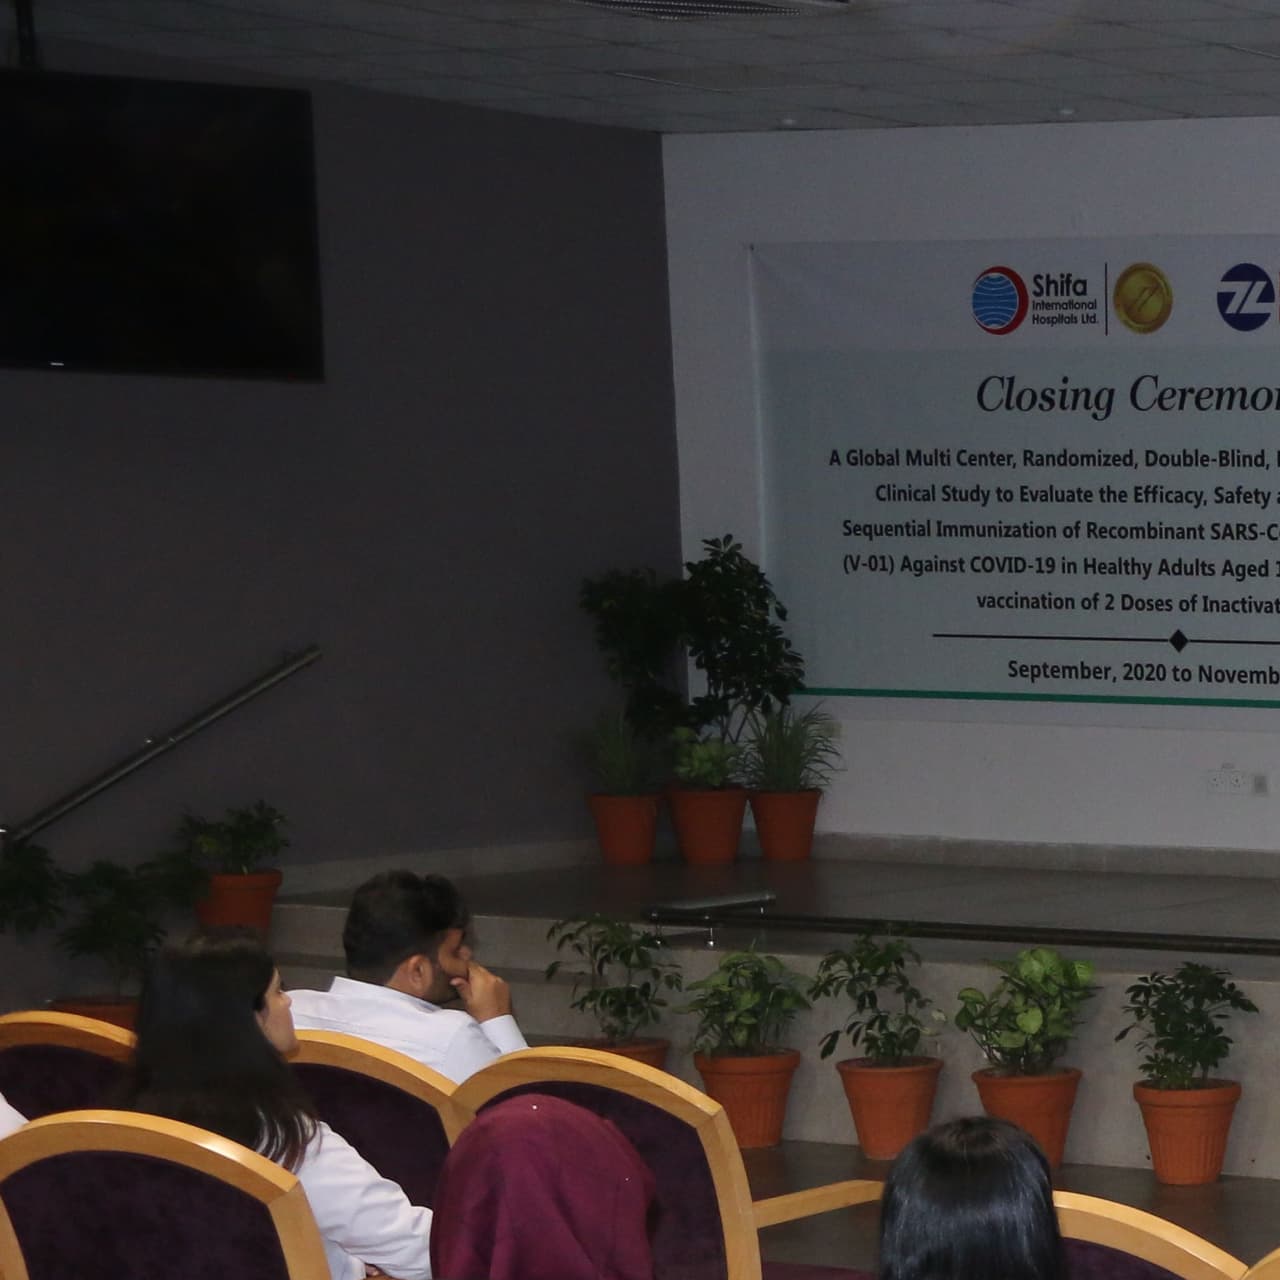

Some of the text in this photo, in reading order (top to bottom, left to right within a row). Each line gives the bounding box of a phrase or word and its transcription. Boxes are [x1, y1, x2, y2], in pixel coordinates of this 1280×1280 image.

[1032, 272, 1088, 298] Shifa
[1031, 299, 1098, 311] International
[1031, 313, 1099, 328] Hospitals Ltd.
[976, 375, 1116, 422] Closing
[829, 449, 842, 466] A
[846, 448, 900, 467] Global
[905, 448, 951, 467] Multi
[956, 448, 1017, 469] Center,
[1023, 448, 1139, 470] Randomized,
[1144, 448, 1270, 471] Double-Blind,
[875, 483, 936, 502] Clinical
[941, 483, 991, 508] Study
[995, 486, 1014, 503] to
[1019, 484, 1094, 503] Evaluate
[1098, 484, 1129, 504] the
[1133, 484, 1208, 510] Efficacy,
[1213, 485, 1272, 510] Safety
[842, 519, 931, 542] Sequential
[936, 520, 1057, 539] Immunization
[1062, 520, 1082, 539] of
[1086, 521, 1206, 541] Recombinant
[843, 554, 895, 575] (V-01)
[900, 554, 966, 578] Against
[970, 555, 1056, 575] COVID-19
[1061, 556, 1078, 575] in
[1083, 556, 1153, 581] Healthy
[1157, 557, 1216, 577] Adults
[1221, 559, 1270, 583] Aged
[976, 591, 1076, 610] vaccination
[1080, 591, 1100, 611] of
[1104, 593, 1115, 611] 2
[1120, 593, 1174, 613] Doses
[1178, 593, 1198, 613] of
[1007, 659, 1117, 684] September,
[1122, 662, 1167, 682] 2020
[1171, 665, 1193, 683] to
